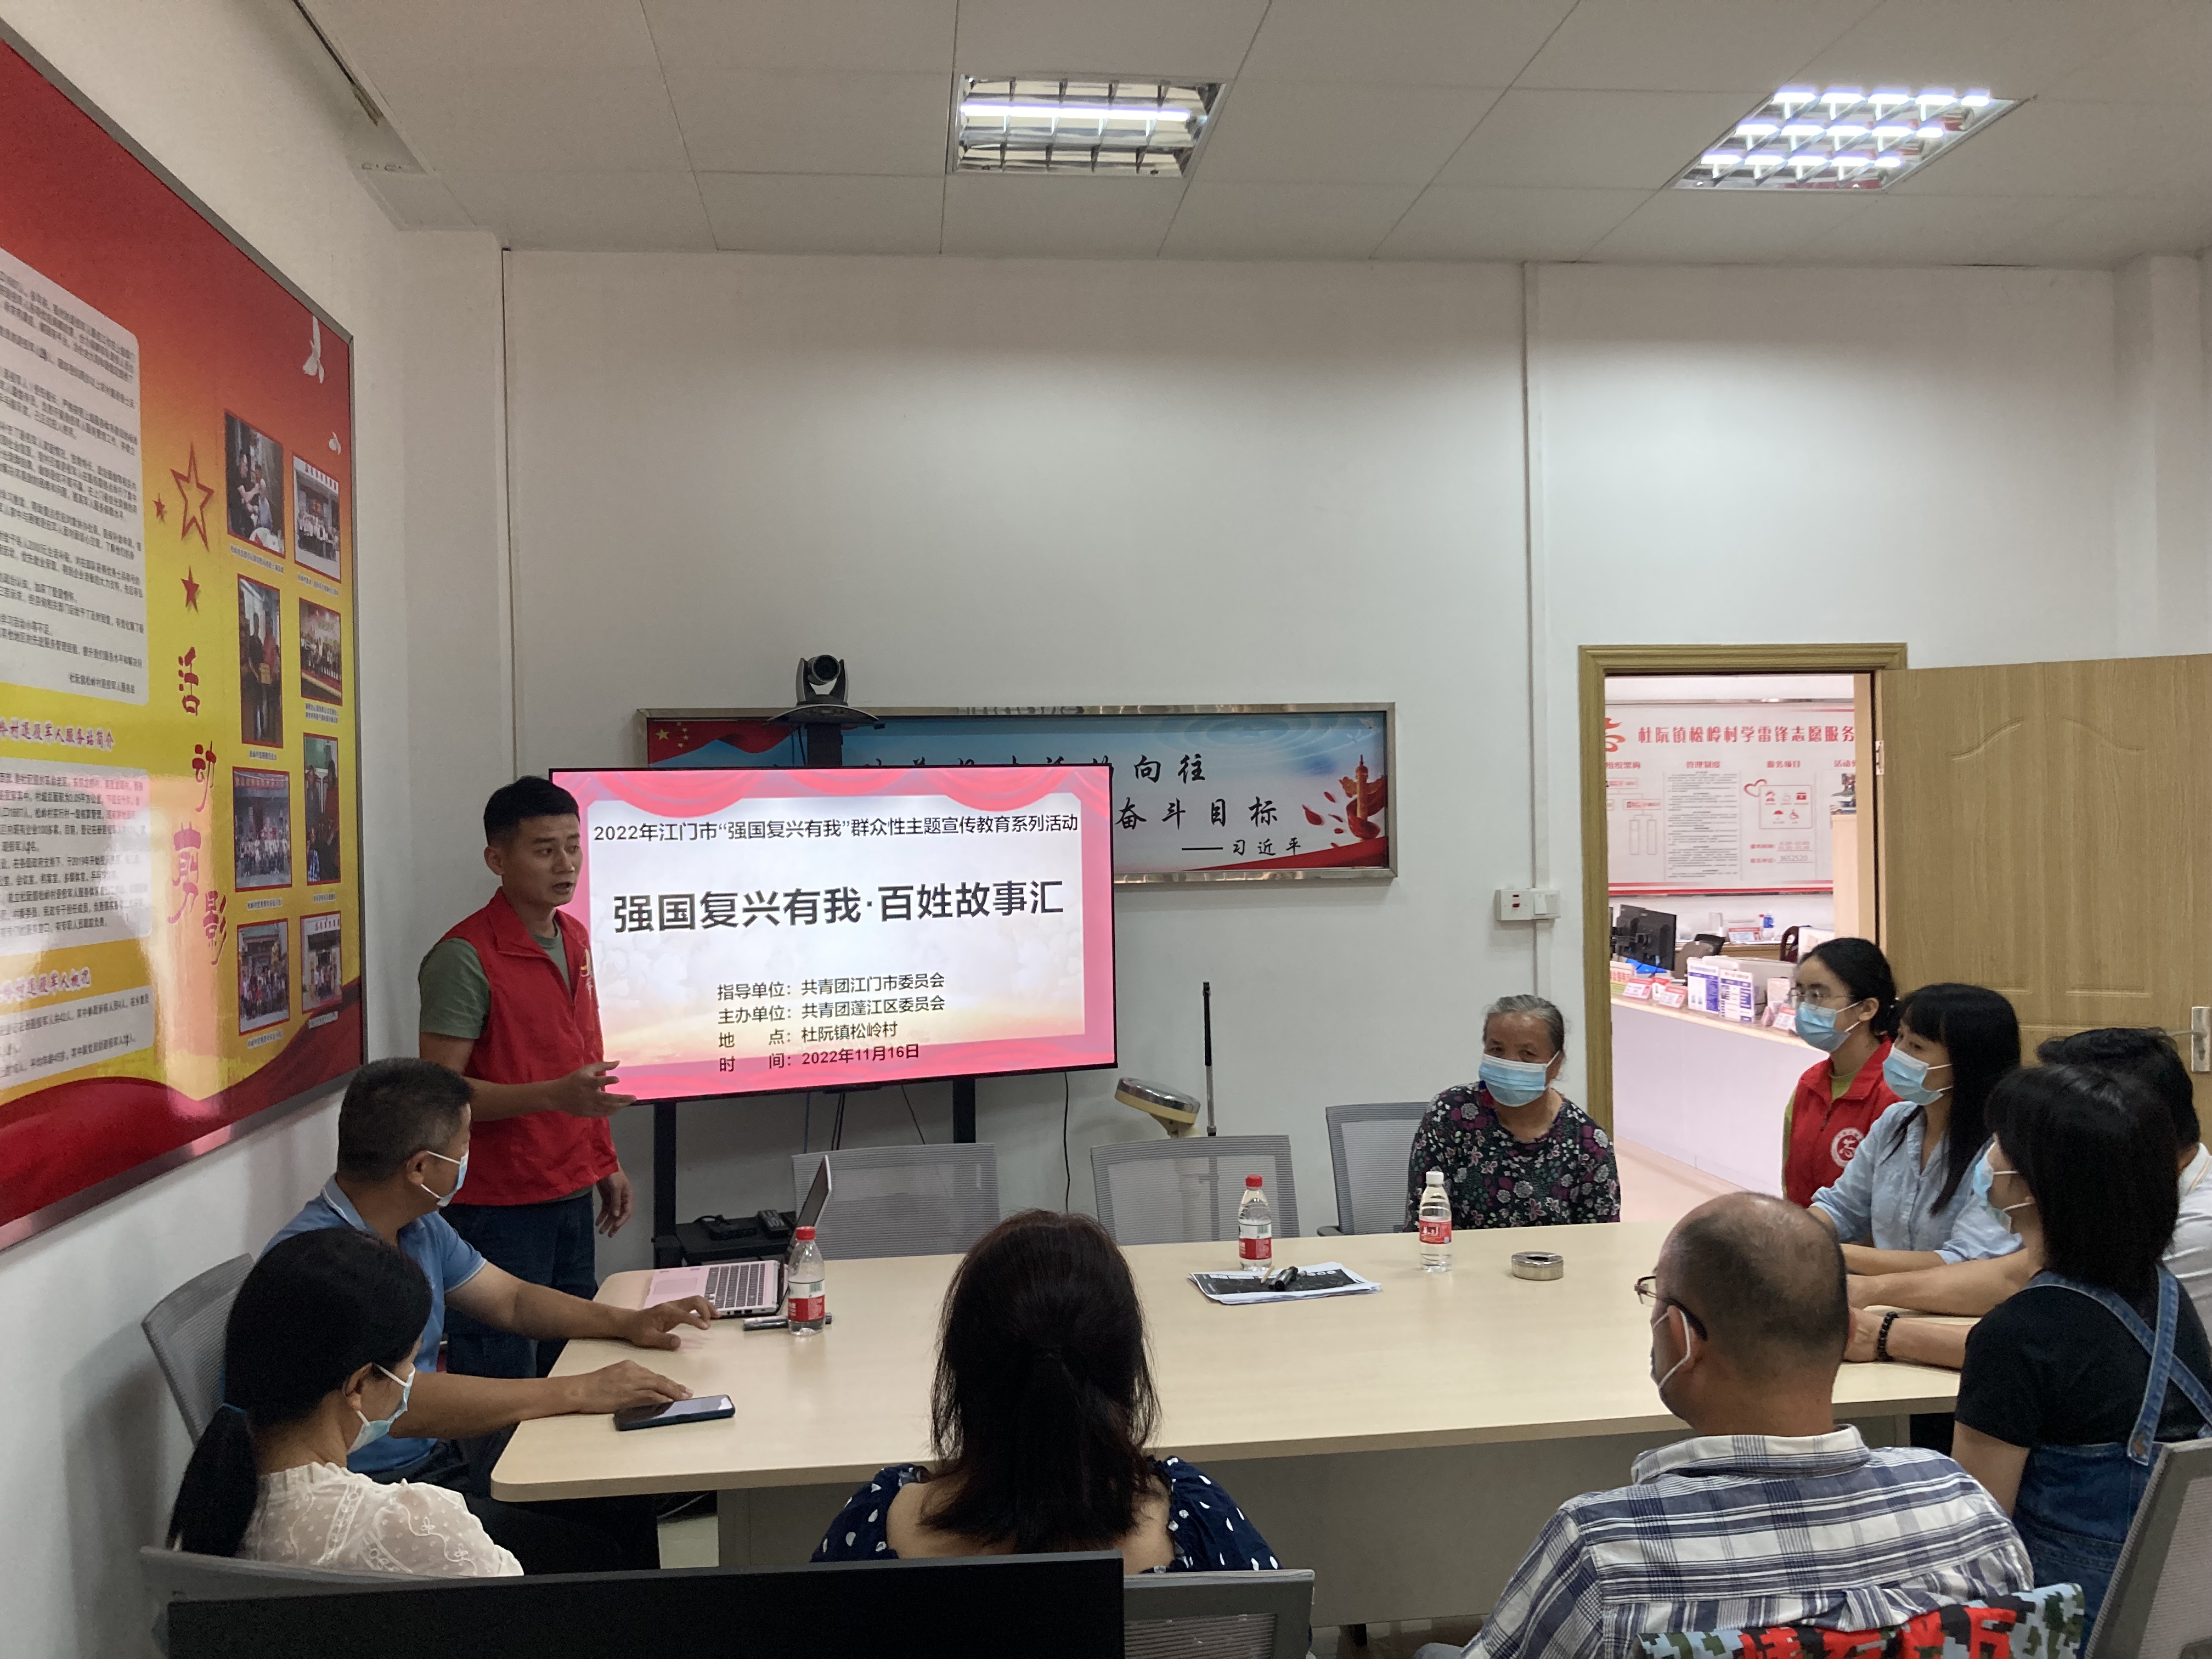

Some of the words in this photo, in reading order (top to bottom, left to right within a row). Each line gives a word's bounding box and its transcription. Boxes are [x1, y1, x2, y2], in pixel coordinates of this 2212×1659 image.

[167, 647, 227, 966] 活动剪影
[1115, 797, 1278, 830] 奋斗目标
[613, 880, 1064, 933] 强国复兴有我·百姓故事汇
